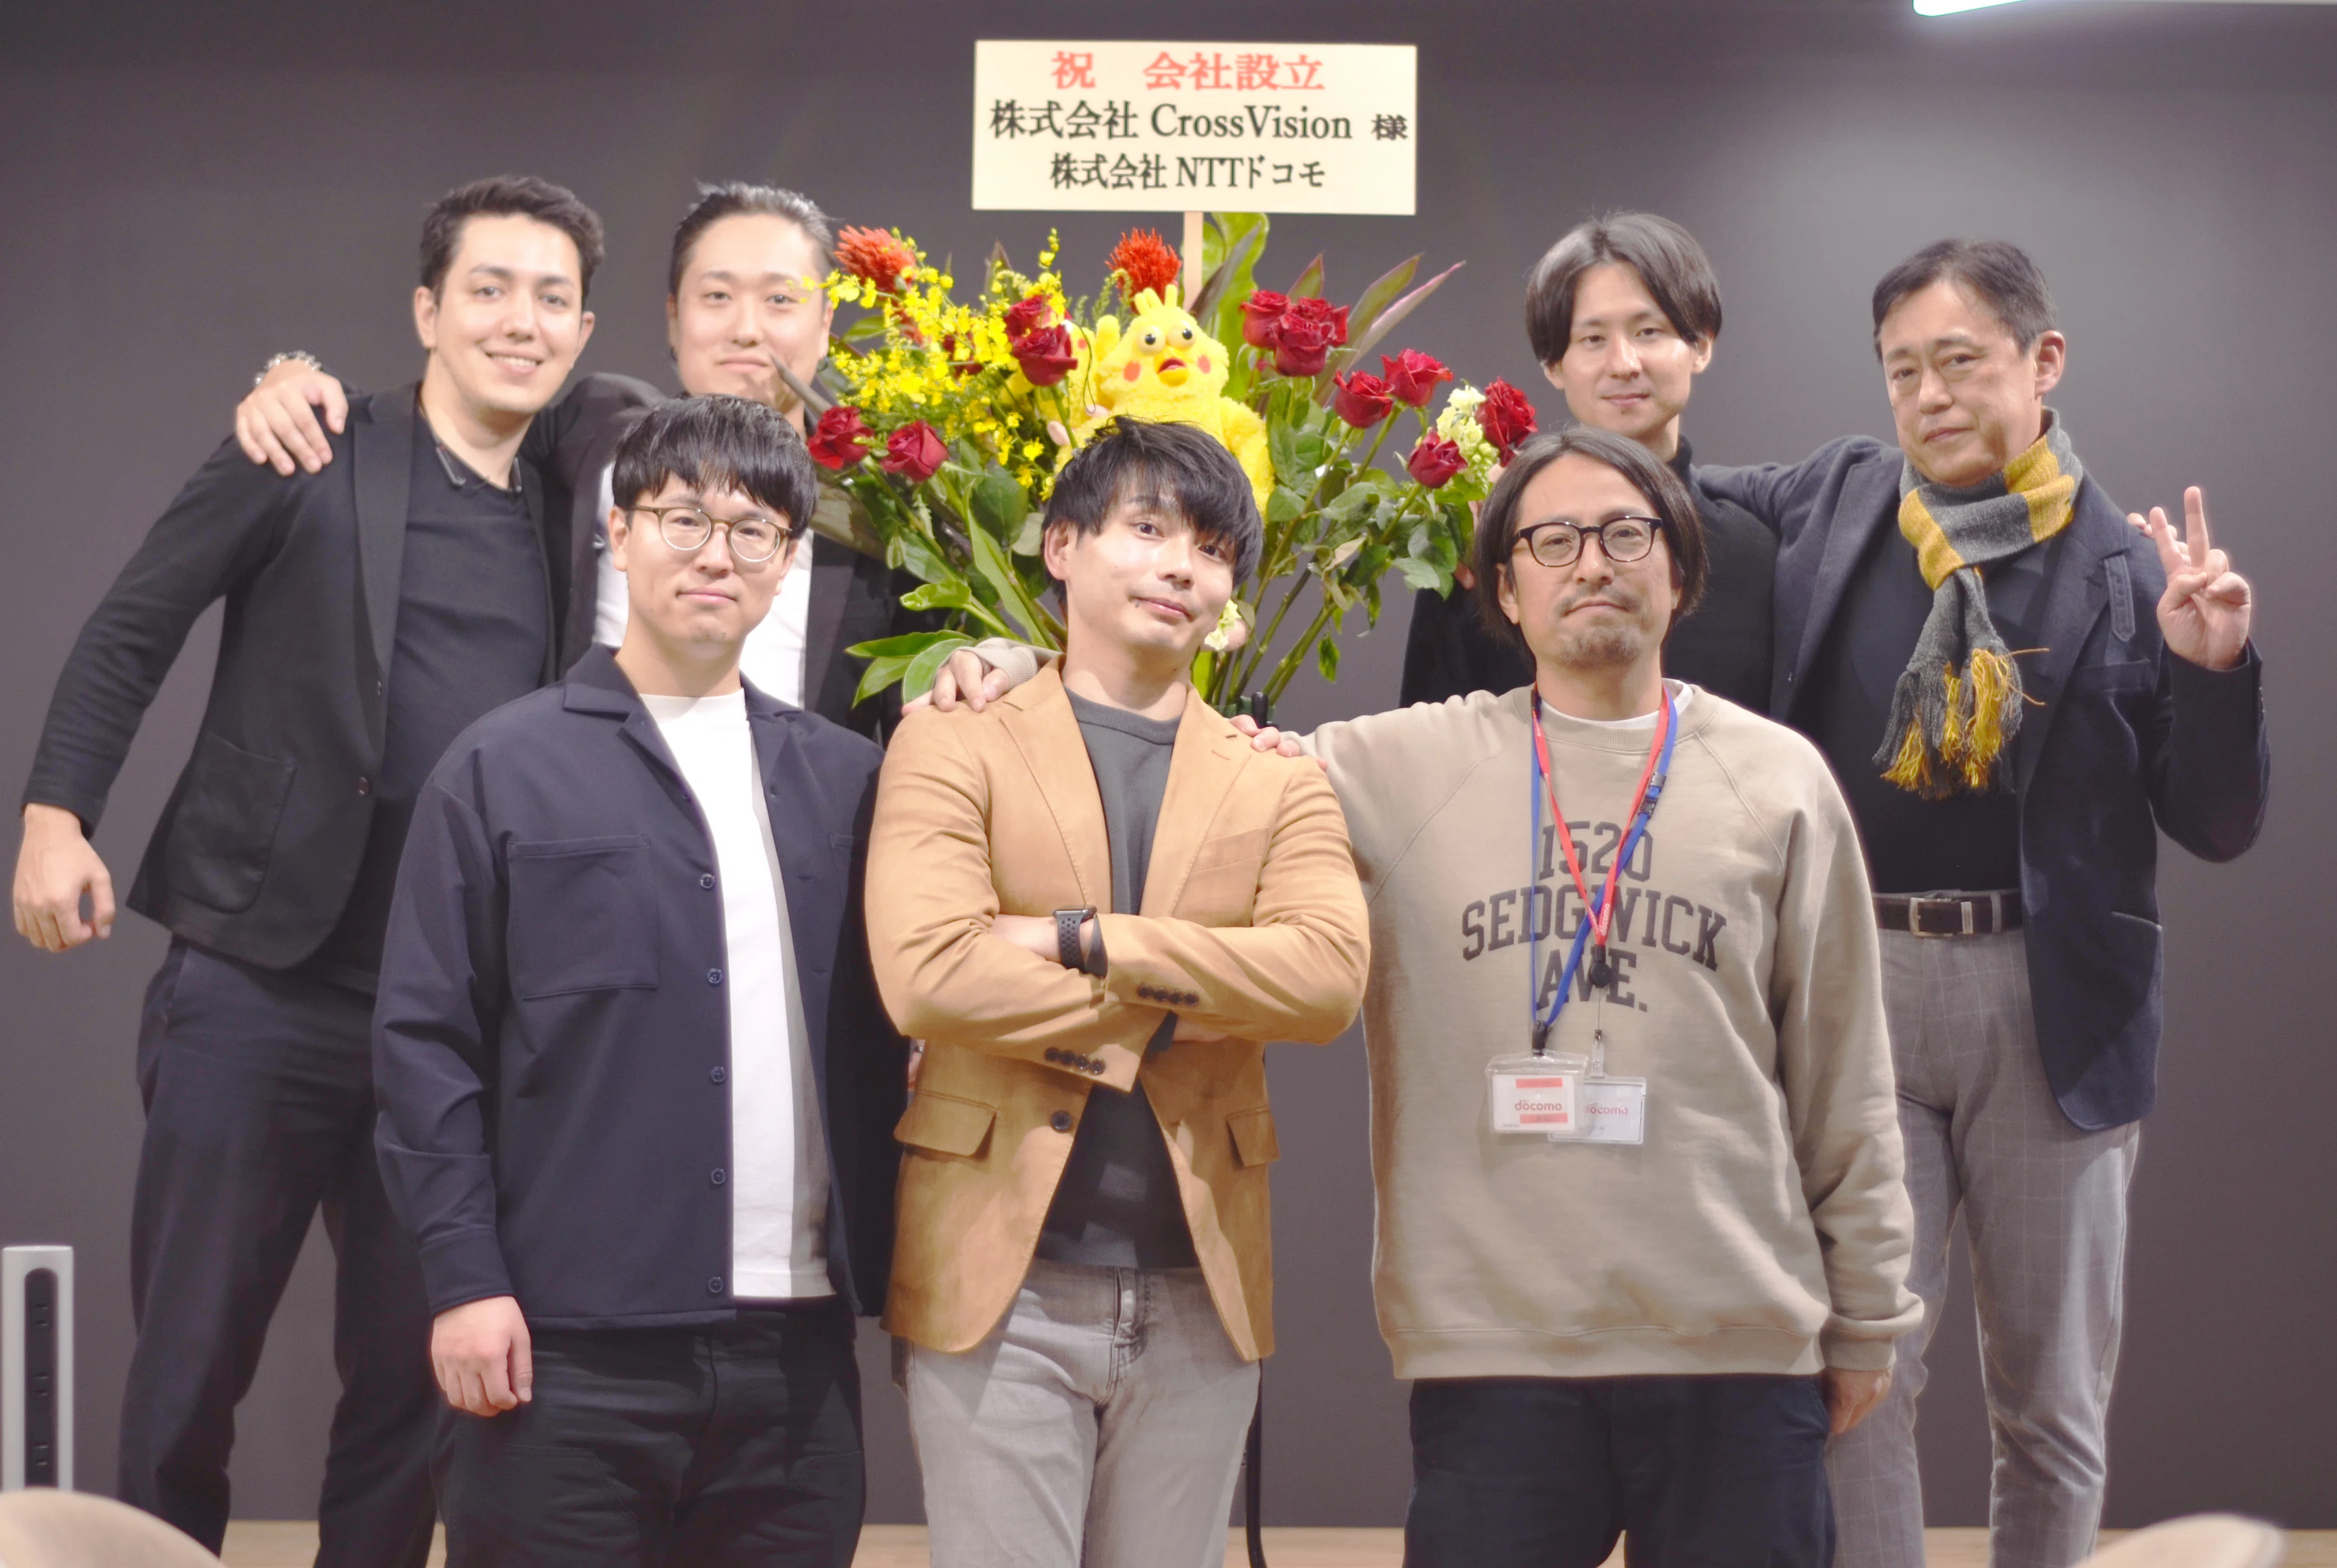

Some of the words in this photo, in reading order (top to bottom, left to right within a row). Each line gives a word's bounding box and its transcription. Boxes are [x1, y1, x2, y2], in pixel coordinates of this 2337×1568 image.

[1050, 50, 1098, 91] 祝
[1142, 50, 1327, 92] 会社設立
[990, 99, 1139, 141] 株式会社
[1150, 102, 1353, 141] CrossVision
[1371, 113, 1408, 142] 様
[1050, 152, 1167, 191] 株式会社
[1176, 154, 1326, 190] NTTドコモ
[1539, 821, 1654, 883] 1520
[1461, 883, 1727, 972] SEDGWICK
[1600, 902, 1610, 936] docomo
[1536, 945, 1647, 1012] AVE.
